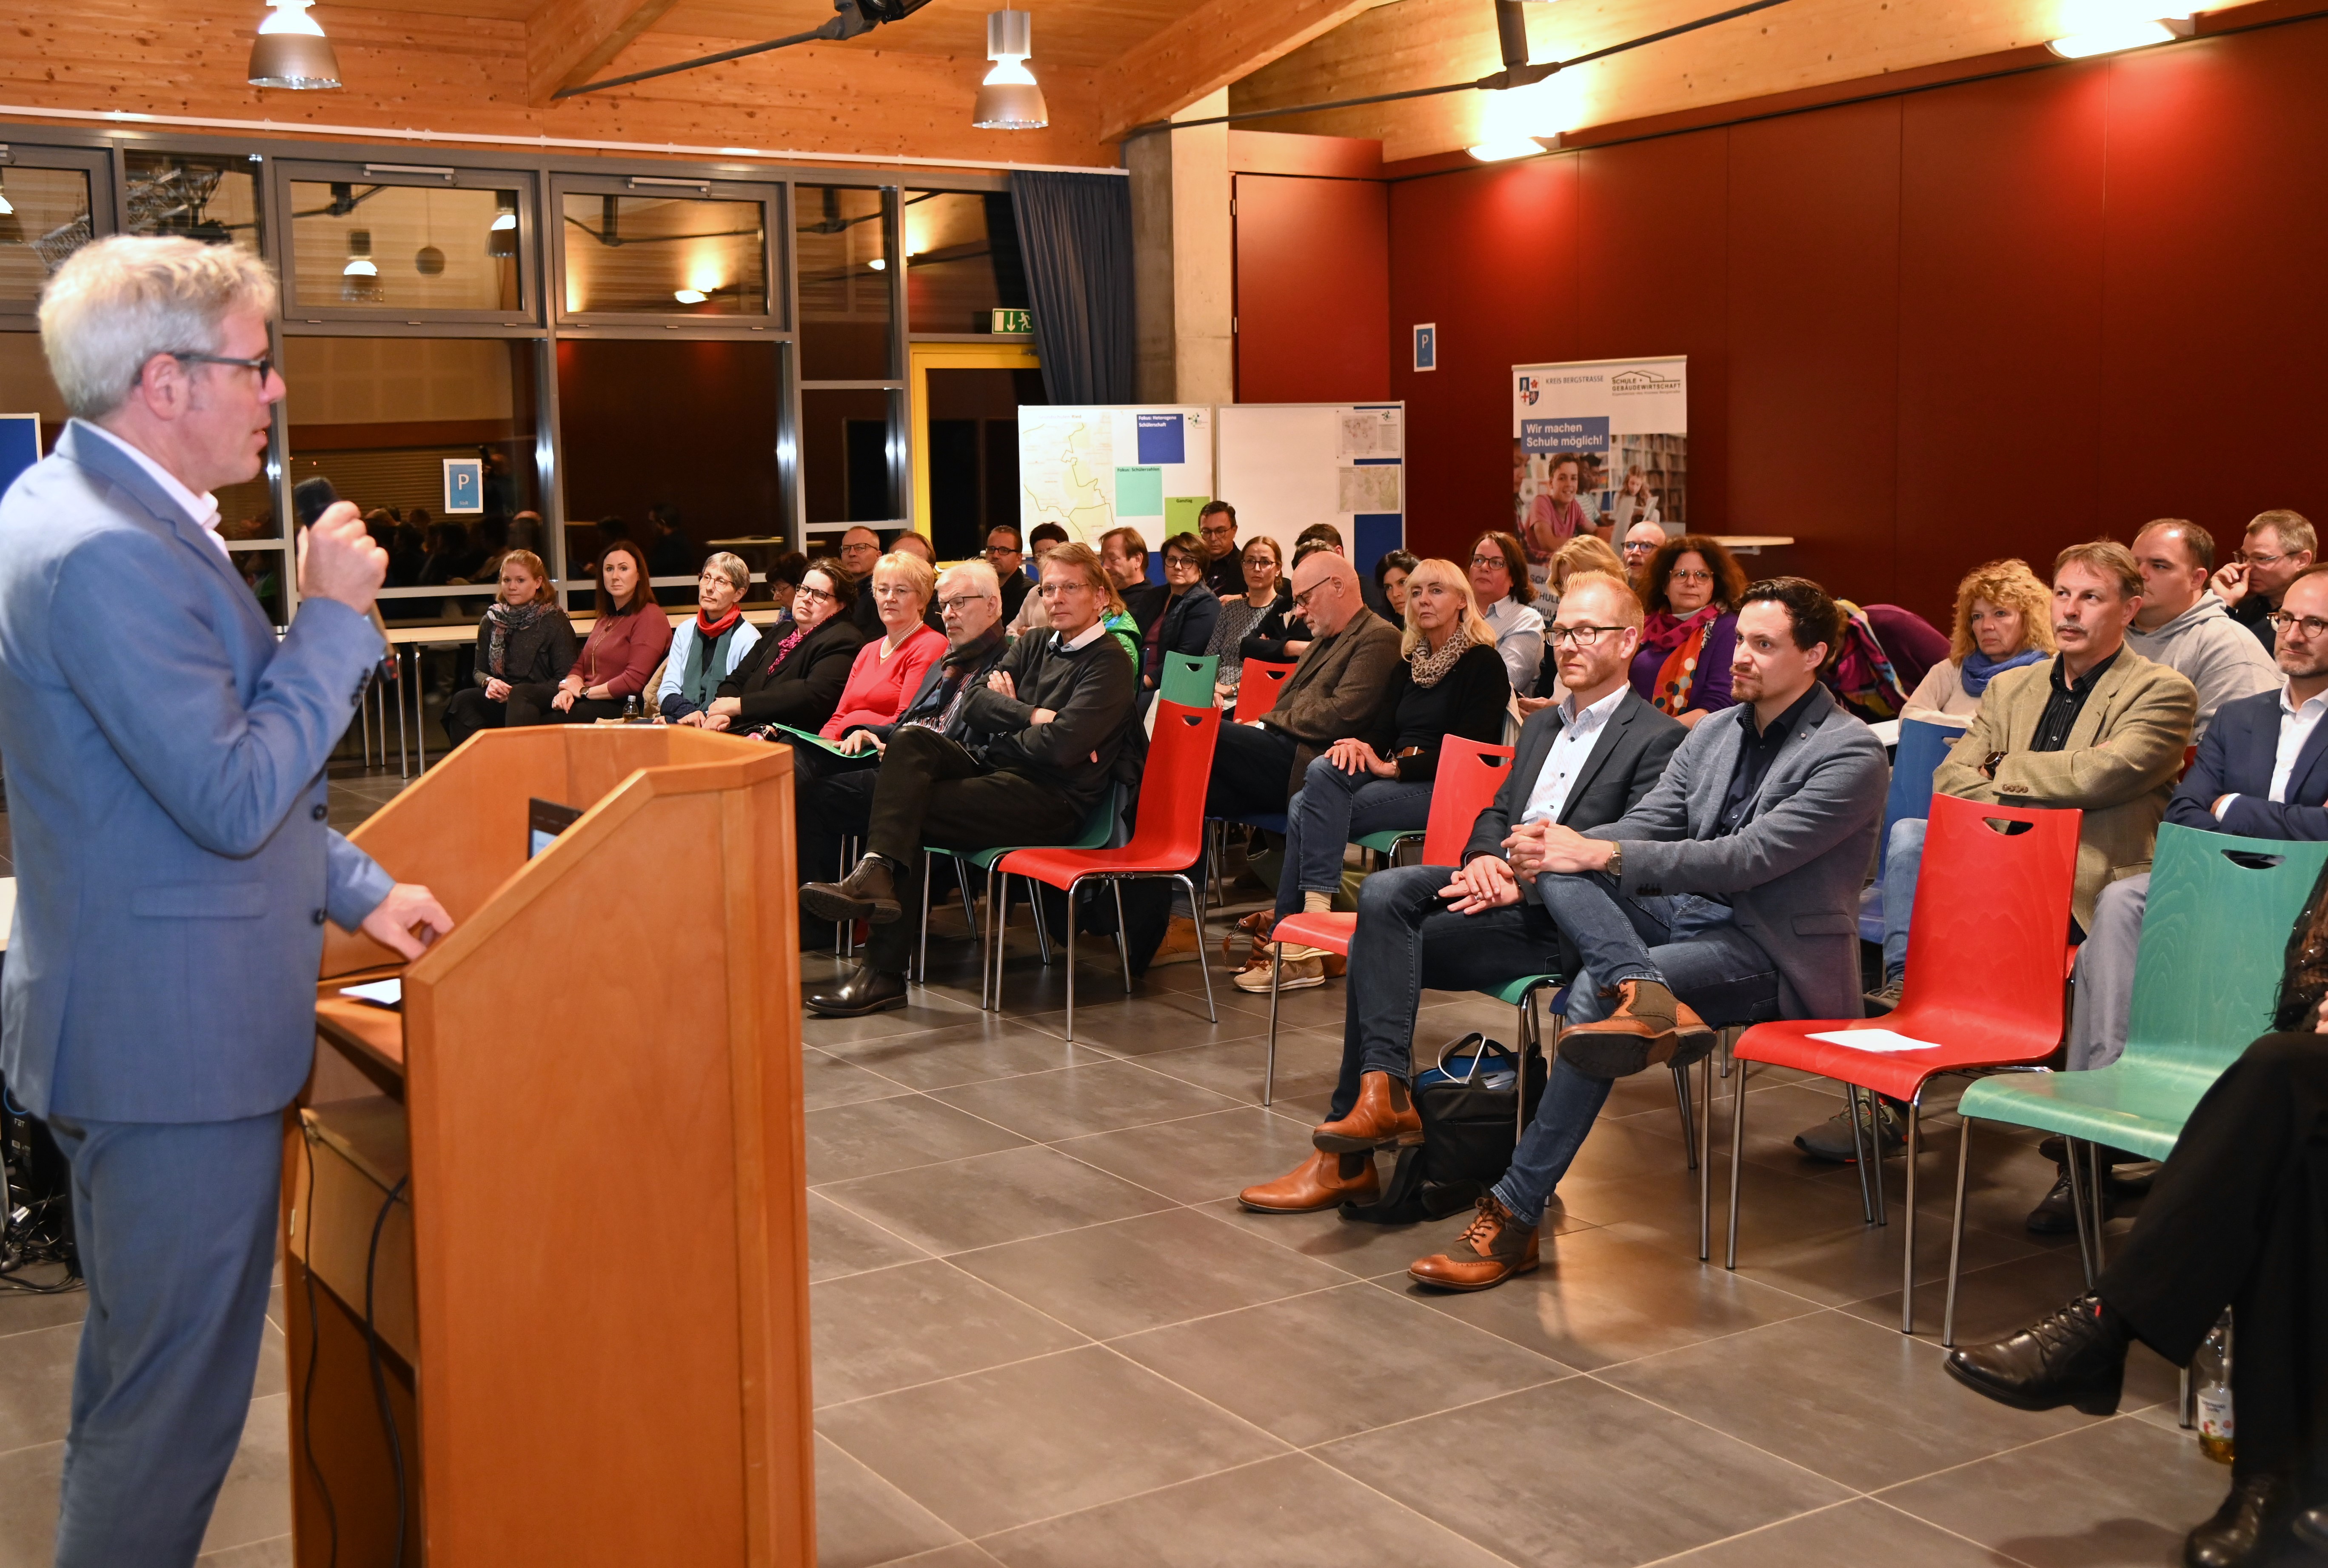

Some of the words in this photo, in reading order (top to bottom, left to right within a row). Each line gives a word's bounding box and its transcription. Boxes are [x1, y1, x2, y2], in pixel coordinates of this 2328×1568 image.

[1422, 334, 1429, 349] P
[1612, 383, 1680, 391] GEBÄUDEWIRTSCHAFT
[1526, 423, 1542, 434] Wir
[1545, 422, 1583, 433] machen
[1526, 436, 1558, 447] Schule
[1561, 434, 1603, 448] möglich!
[458, 473, 469, 490] P
[1530, 574, 1548, 584] SCH
[14, 1117, 25, 1128] FBT
